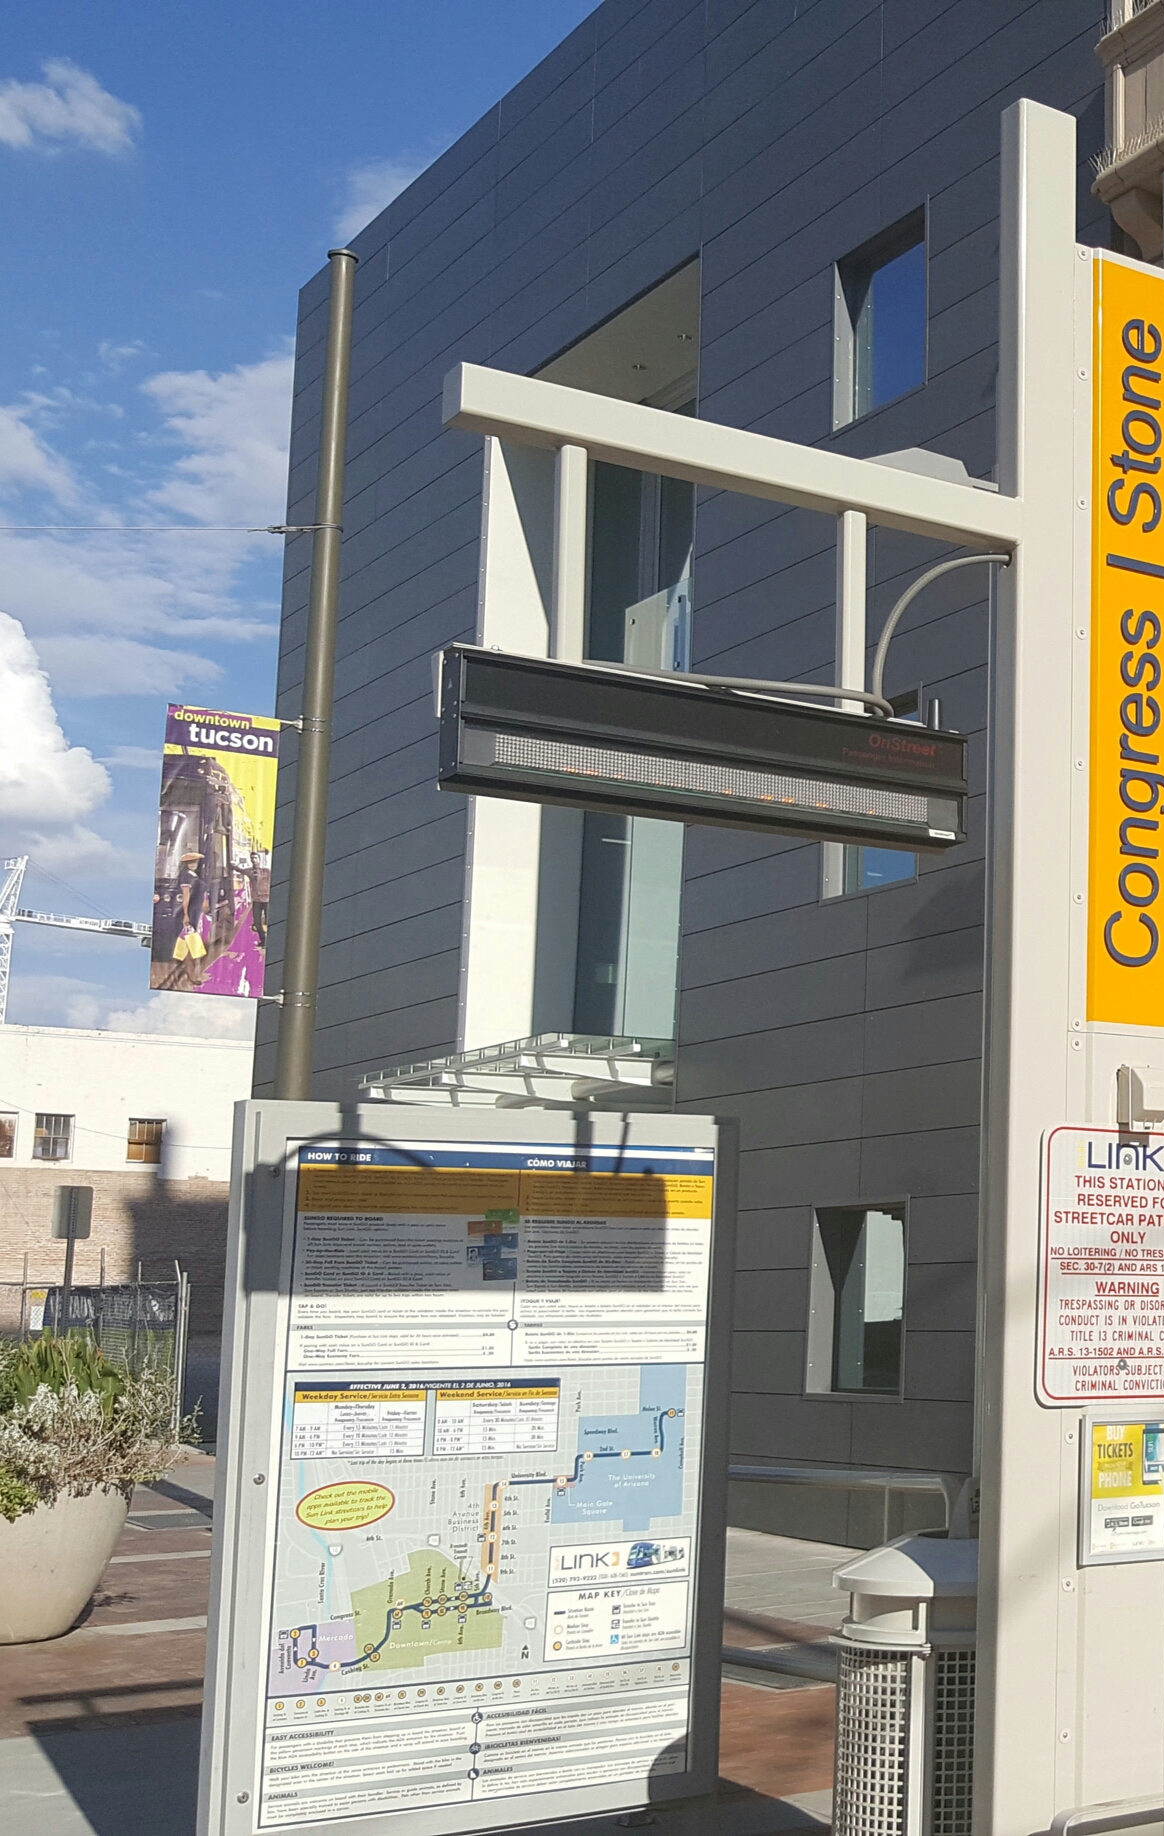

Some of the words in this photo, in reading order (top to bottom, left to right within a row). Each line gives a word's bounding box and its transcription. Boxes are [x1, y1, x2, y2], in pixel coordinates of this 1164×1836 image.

[1107, 316, 1163, 534] Stone
[174, 709, 250, 730] downtown
[189, 724, 273, 752] tucson
[869, 734, 936, 756] OnStreet
[308, 1152, 332, 1160] HOW
[350, 1153, 371, 1161] RIDE
[528, 1158, 554, 1167] CÓMO
[556, 1160, 586, 1168] VIAJAR
[1075, 1175, 1105, 1189] THIS
[1078, 1194, 1148, 1208] RESERVED
[1054, 1211, 1134, 1226] STREETCAR
[1110, 1231, 1147, 1244] ONLY
[1050, 1247, 1064, 1256] NO
[1068, 1247, 1117, 1257] LOITERING
[1119, 1248, 1123, 1258] /
[1125, 1249, 1138, 1258] NO
[1060, 1261, 1081, 1271] SEC.
[1084, 1262, 1115, 1273] 30-7(2)
[1118, 1263, 1137, 1272] AND
[1140, 1264, 1158, 1272] ARS
[1096, 1281, 1160, 1295] WARNING
[1059, 1299, 1119, 1311] TRESPASSING
[1124, 1300, 1135, 1311] OR
[1059, 1315, 1099, 1326] CONDUCT
[1105, 1315, 1113, 1326] IS
[1118, 1315, 1127, 1326] IN
[1071, 1330, 1093, 1342] TITLE
[1099, 1330, 1107, 1341] 13
[1112, 1331, 1154, 1341] CRIMINAL
[1048, 1348, 1076, 1356] A.R.S.
[1080, 1347, 1114, 1356] 13-1502
[1117, 1347, 1136, 1356] AND
[1138, 1347, 1164, 1356] A.R.S.
[1073, 1365, 1120, 1376] VIOLATORS
[1125, 1364, 1163, 1375] SUBJECT
[1075, 1380, 1118, 1391] CRIMINAL
[1107, 1425, 1125, 1440] BUY
[1097, 1442, 1133, 1459] TICKETS
[1099, 1472, 1132, 1488] PHONE
[335, 1506, 364, 1514] streetcars
[1098, 1503, 1128, 1511] Download
[578, 1592, 599, 1600] MAP
[319, 1634, 353, 1642] Mercado
[289, 1730, 334, 1739] ACCESSIBILITY
[270, 1765, 298, 1773] BICYCLES
[300, 1762, 334, 1770] WELCOME!
[483, 1767, 513, 1775] ANIMALES
[268, 1792, 298, 1800] ANIMALS
